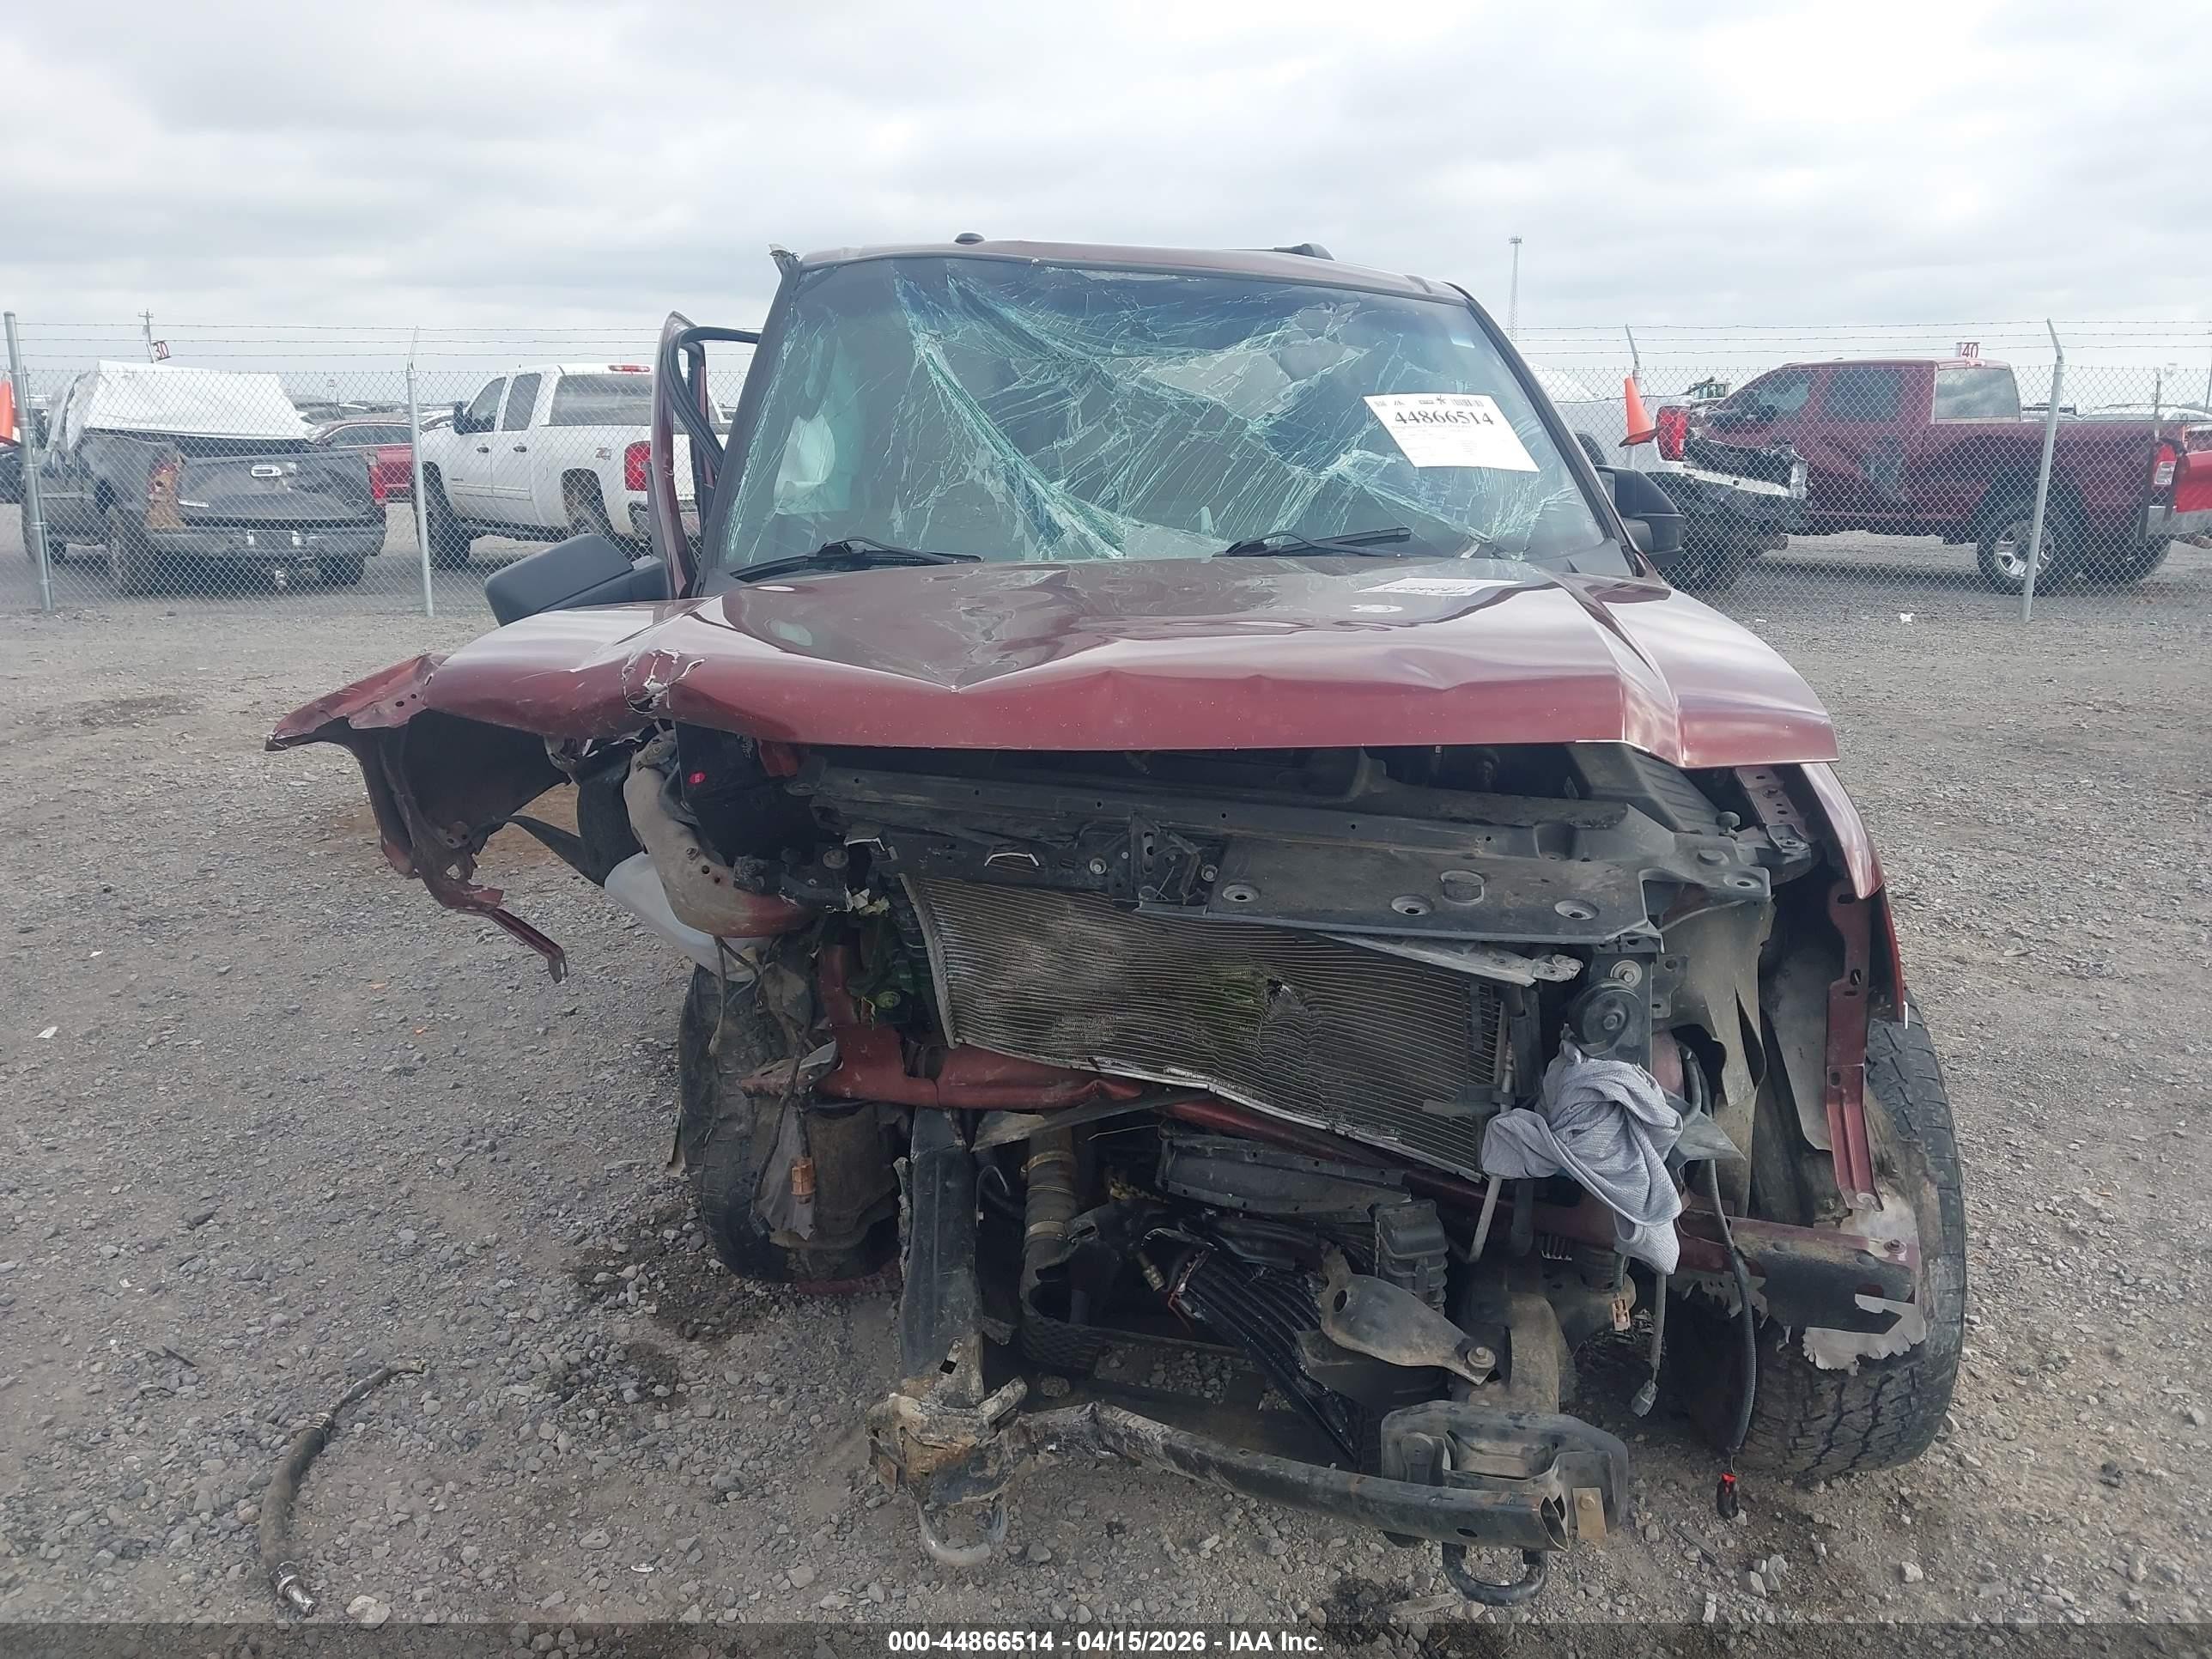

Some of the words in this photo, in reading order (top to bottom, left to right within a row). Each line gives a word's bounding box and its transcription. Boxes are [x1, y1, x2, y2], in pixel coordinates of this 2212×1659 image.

[153, 342, 169, 359] 30
[1961, 343, 1979, 358] 40
[1395, 410, 1494, 426] 44866514
